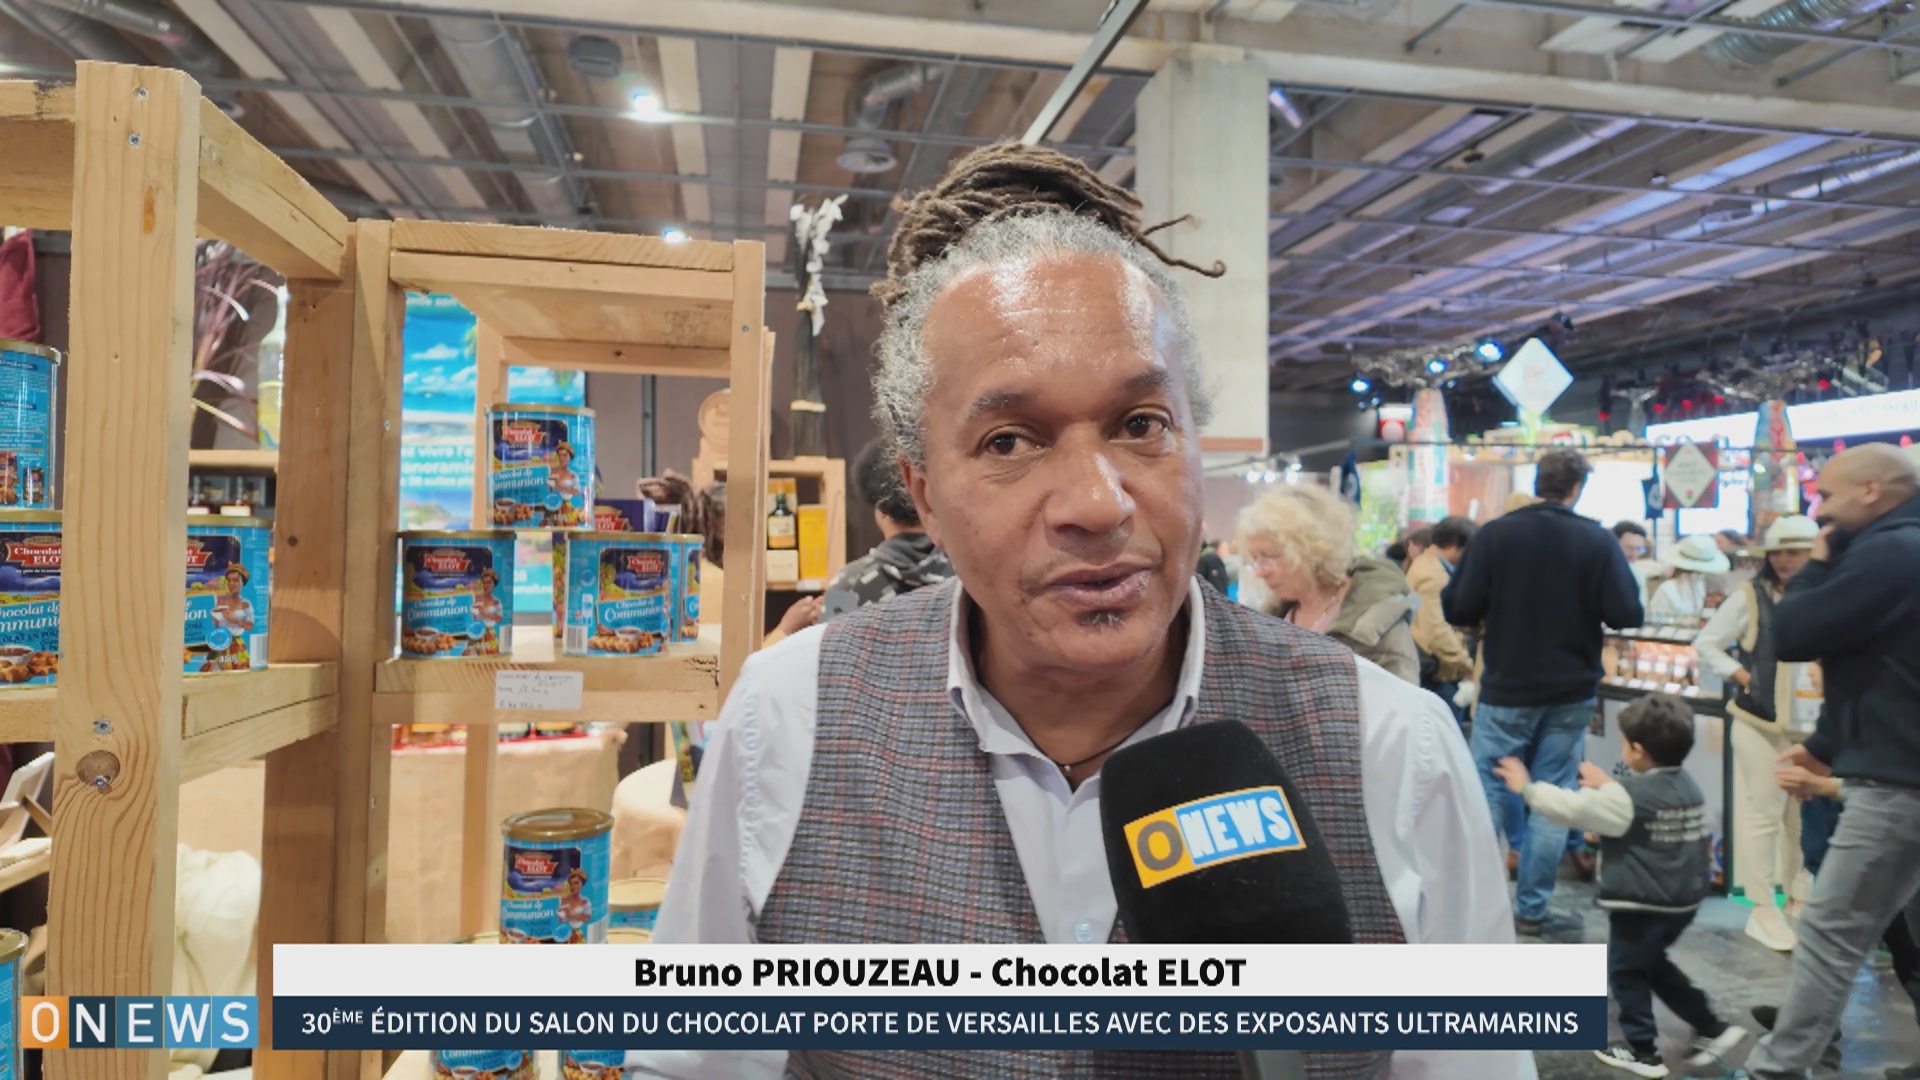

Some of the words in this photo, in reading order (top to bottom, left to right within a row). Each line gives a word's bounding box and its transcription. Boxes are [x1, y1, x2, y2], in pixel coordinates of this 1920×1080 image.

[401, 459, 474, 474] anorami
[493, 477, 545, 490] ommunion
[33, 555, 61, 564] ELO
[415, 597, 446, 608] Chocolat
[0, 604, 44, 618] hocolat
[408, 606, 468, 620] Communion
[0, 615, 60, 633] mmuni
